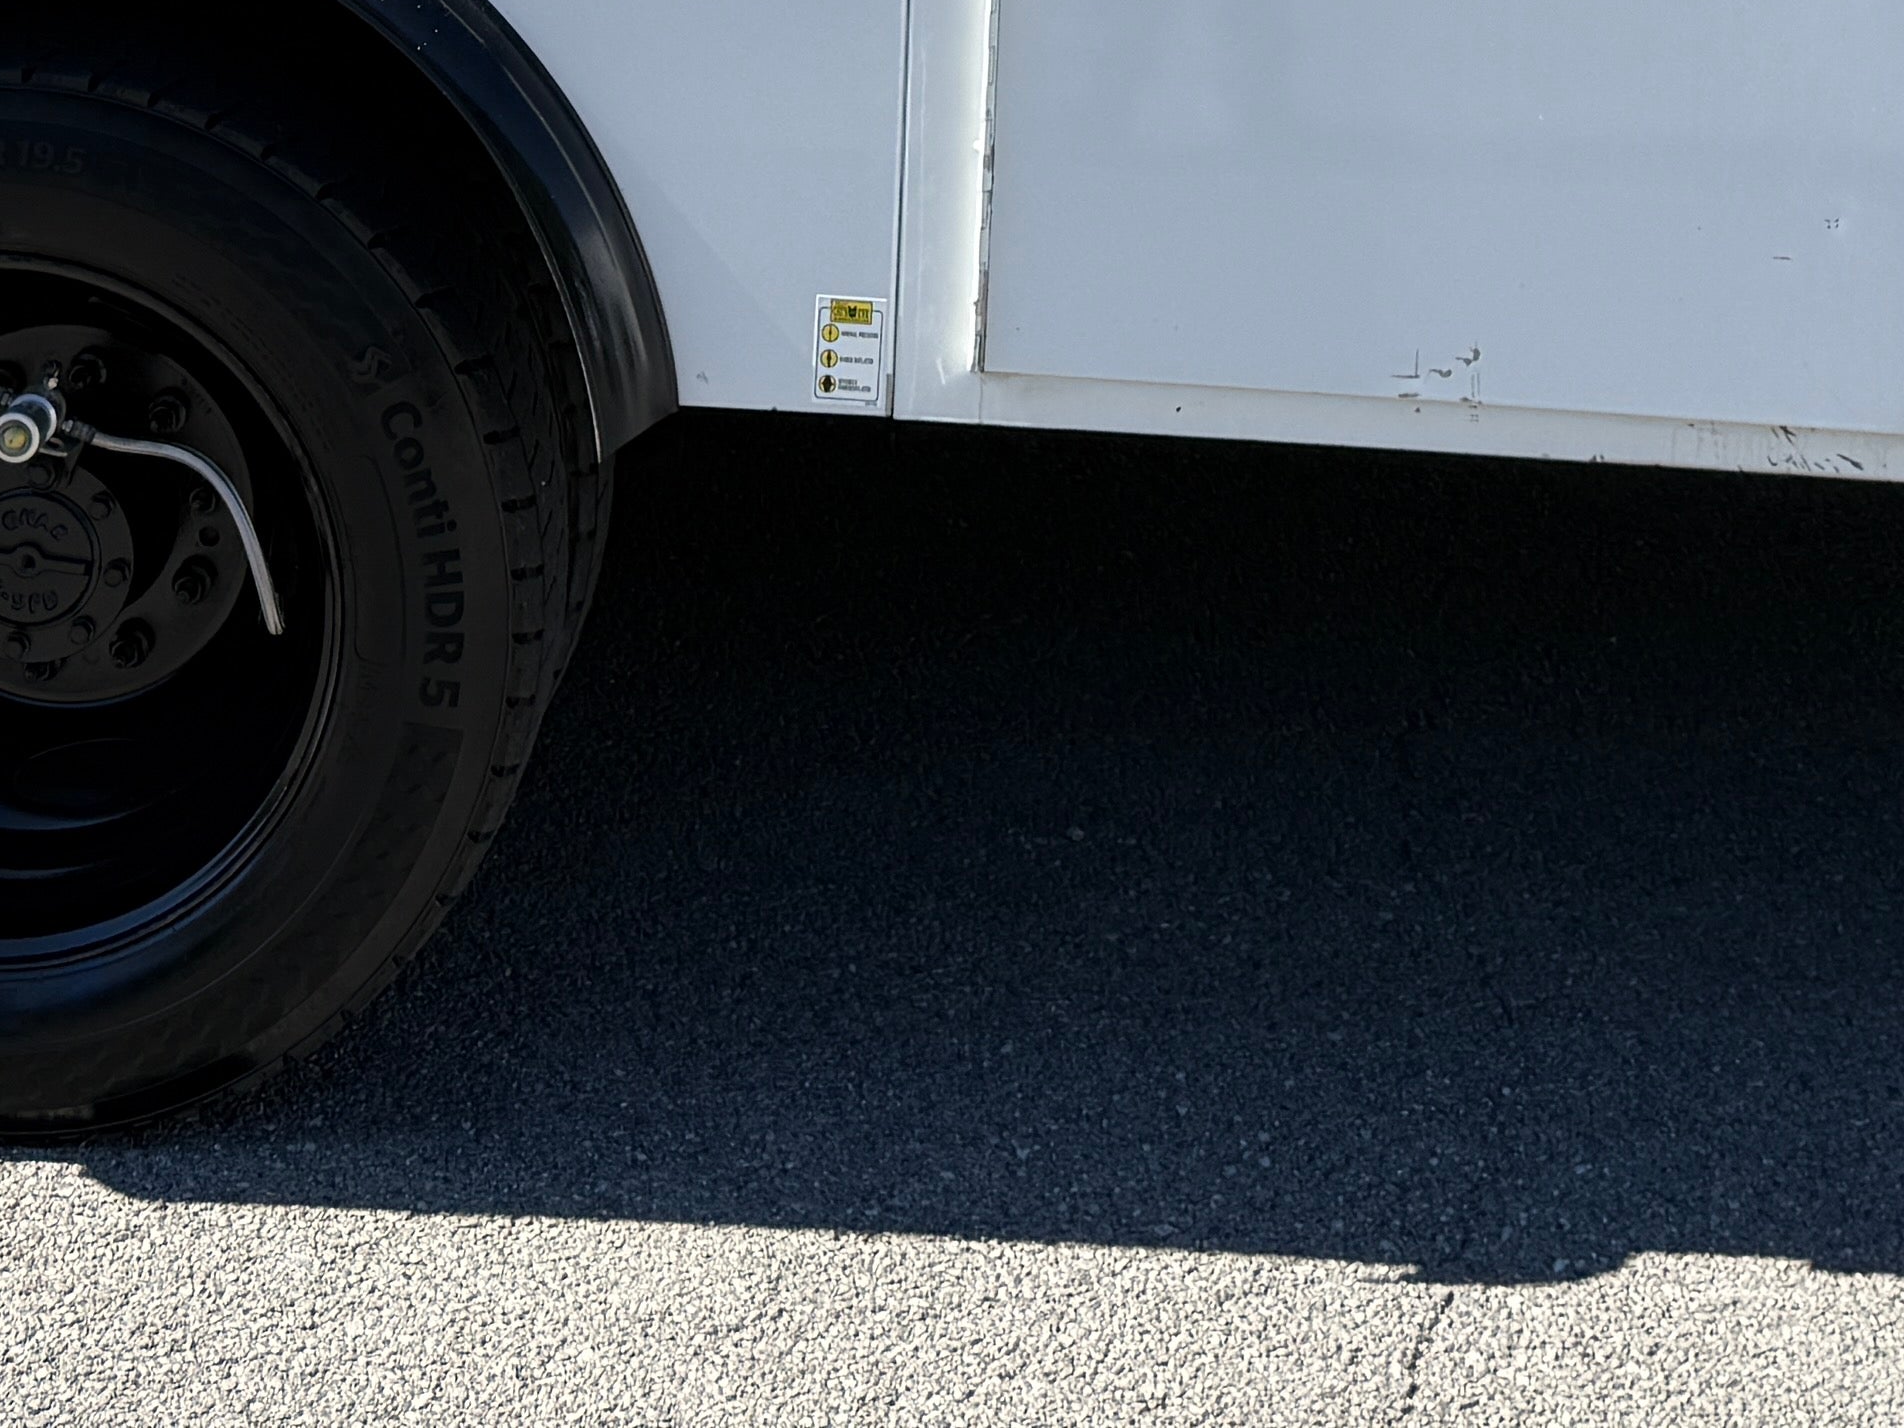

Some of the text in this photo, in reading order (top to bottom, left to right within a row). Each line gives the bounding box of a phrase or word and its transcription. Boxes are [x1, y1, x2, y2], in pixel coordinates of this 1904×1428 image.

[17, 137, 89, 175] 19.5
[381, 400, 465, 709] Conti HDR 5
